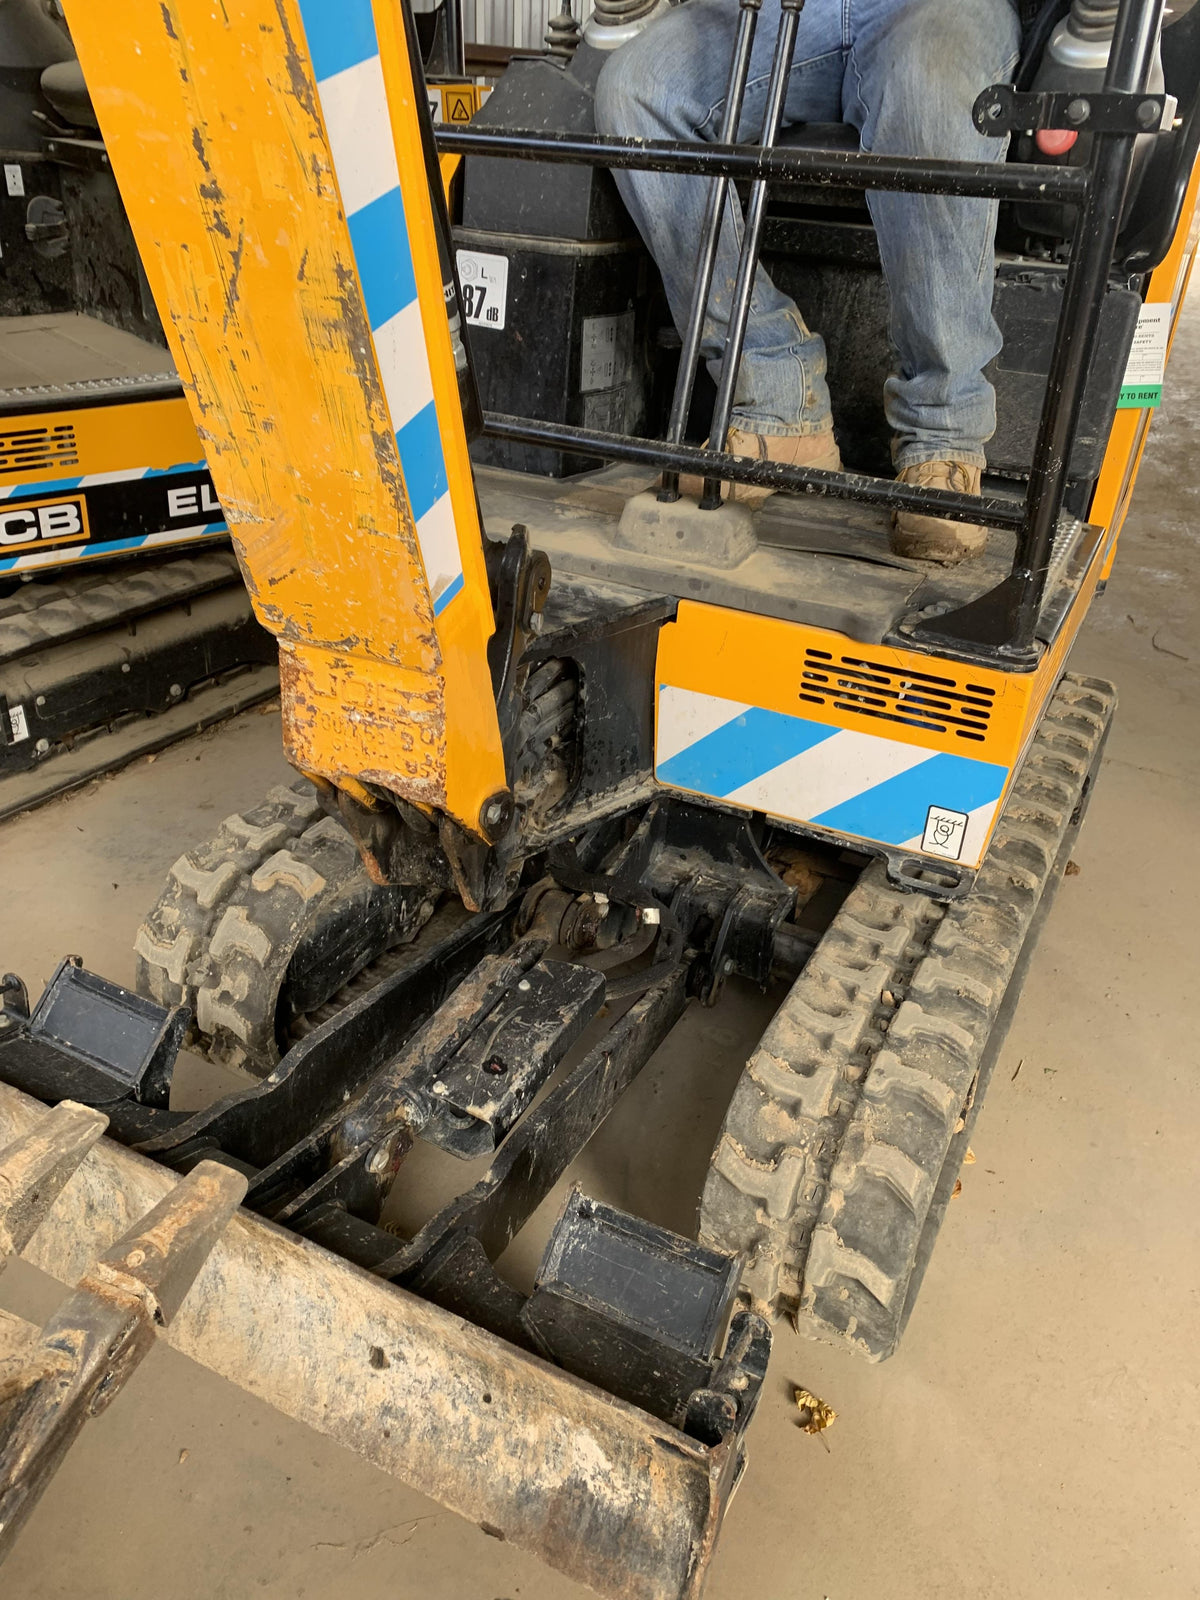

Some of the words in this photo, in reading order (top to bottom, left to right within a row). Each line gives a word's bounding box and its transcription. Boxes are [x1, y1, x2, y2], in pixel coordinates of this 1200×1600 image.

[481, 267, 488, 279] L
[462, 284, 487, 319] 87
[486, 306, 499, 322] dB
[1127, 392, 1136, 400] TO
